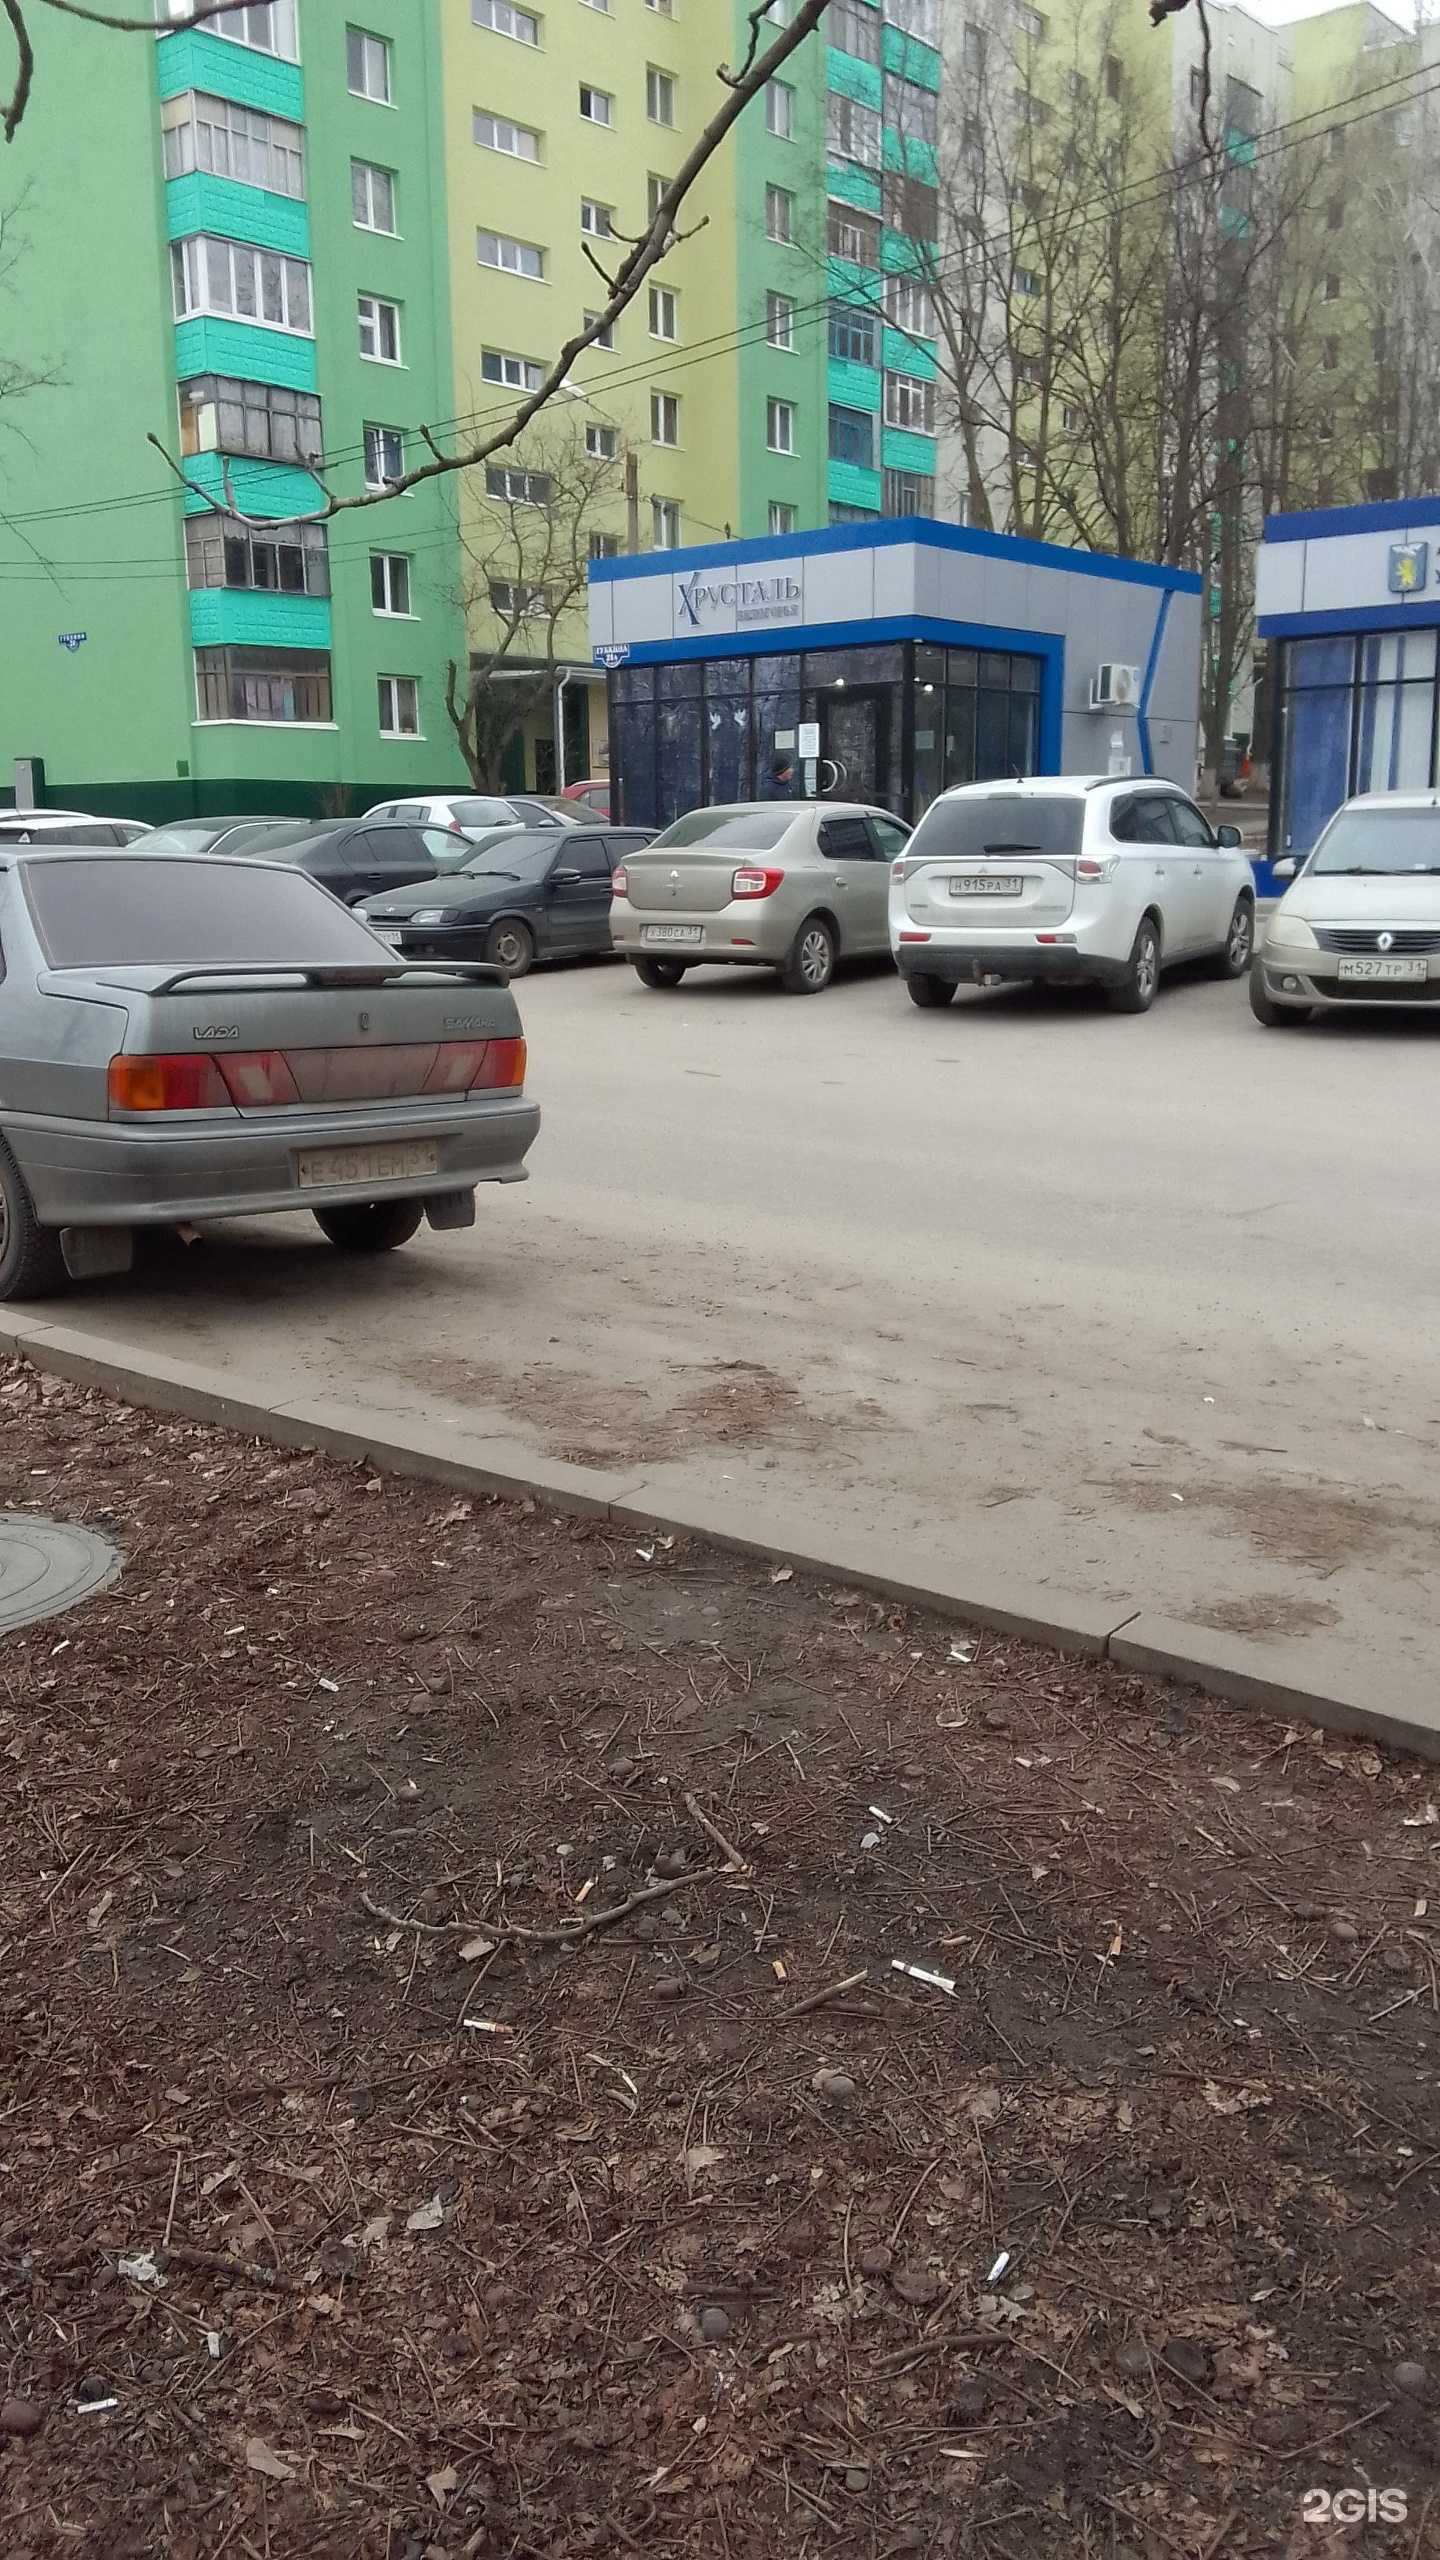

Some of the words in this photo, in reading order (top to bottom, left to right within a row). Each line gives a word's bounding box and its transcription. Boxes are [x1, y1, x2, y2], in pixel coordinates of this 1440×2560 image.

[1005, 879, 1018, 888] 31
[1344, 961, 1402, 975] М527ТР
[193, 1025, 240, 1040] LADA
